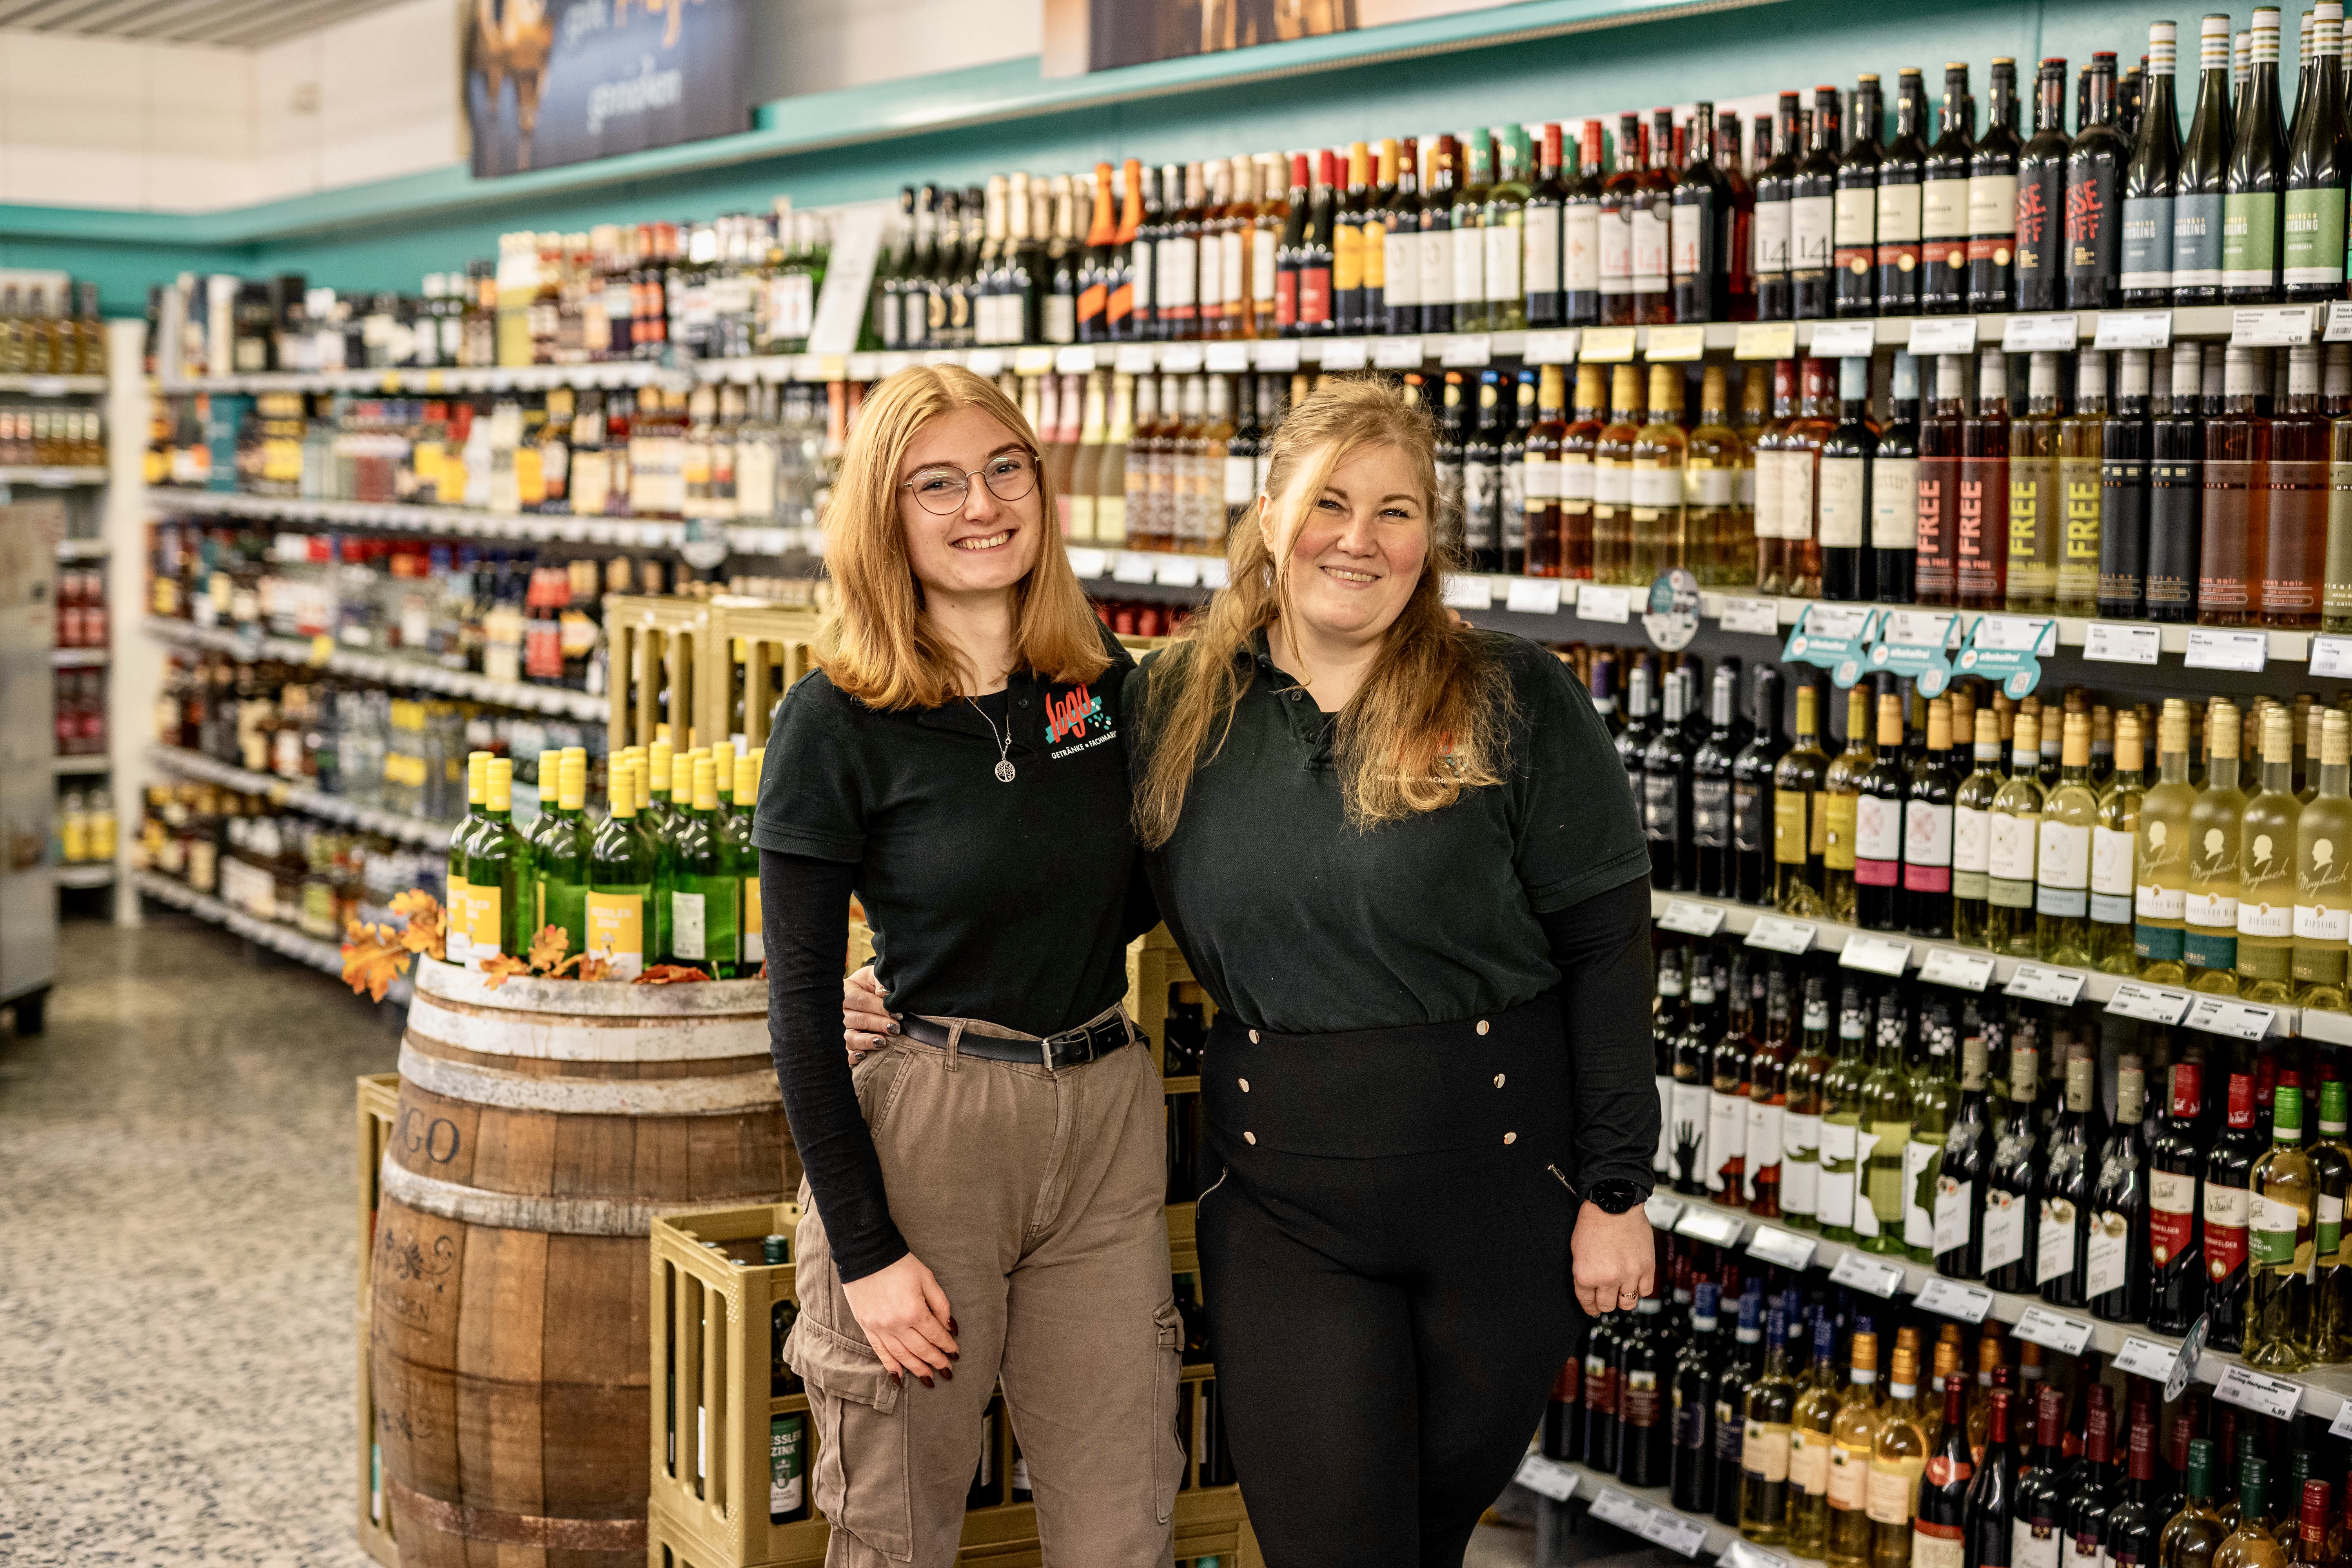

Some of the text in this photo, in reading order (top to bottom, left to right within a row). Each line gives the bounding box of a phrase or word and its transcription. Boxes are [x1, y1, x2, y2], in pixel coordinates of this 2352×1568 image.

[1917, 480, 1940, 554] FREE
[1959, 481, 1982, 555] FREE
[2010, 481, 2036, 556] FREE
[2067, 482, 2100, 558] FREE
[1051, 744, 1084, 759] GETRÄNKE
[2242, 857, 2289, 894] Maybach
[2299, 861, 2349, 898] Maybach
[2305, 919, 2337, 929] RIESLING
[403, 1106, 460, 1164] GO
[771, 1443, 796, 1457] ZINK
